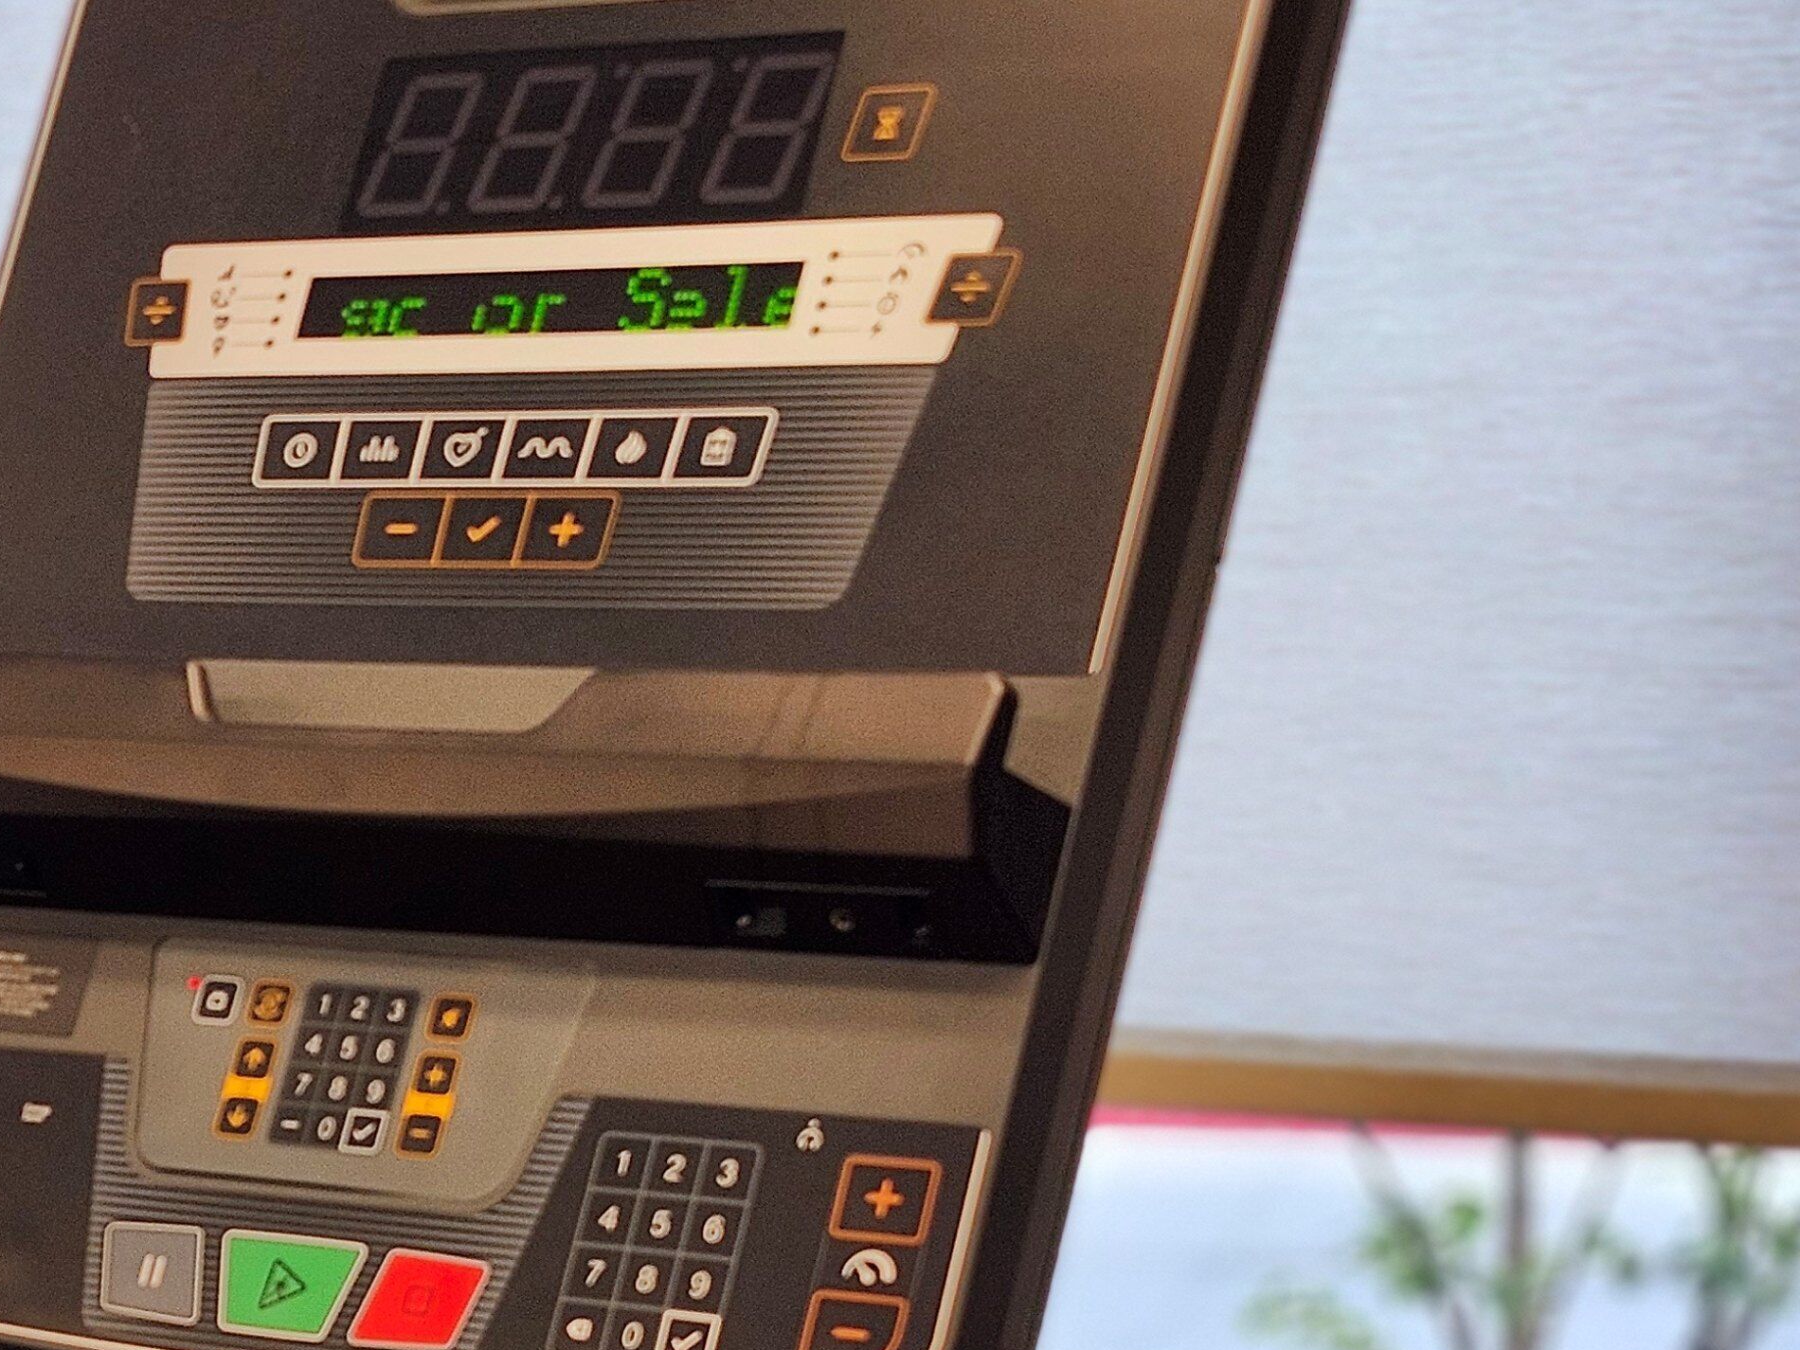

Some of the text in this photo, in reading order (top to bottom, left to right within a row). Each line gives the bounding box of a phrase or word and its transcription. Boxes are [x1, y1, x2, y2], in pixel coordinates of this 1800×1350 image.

[319, 994, 406, 1023] 1 2 3
[305, 1033, 396, 1064] 4 5 6
[295, 1072, 386, 1104] 7 8 9
[317, 1115, 338, 1141] 0
[617, 1150, 740, 1189] 1 2 3
[597, 1205, 726, 1244] 4 5 6
[585, 1258, 712, 1300] 7 8 9
[621, 1321, 645, 1350] 0
